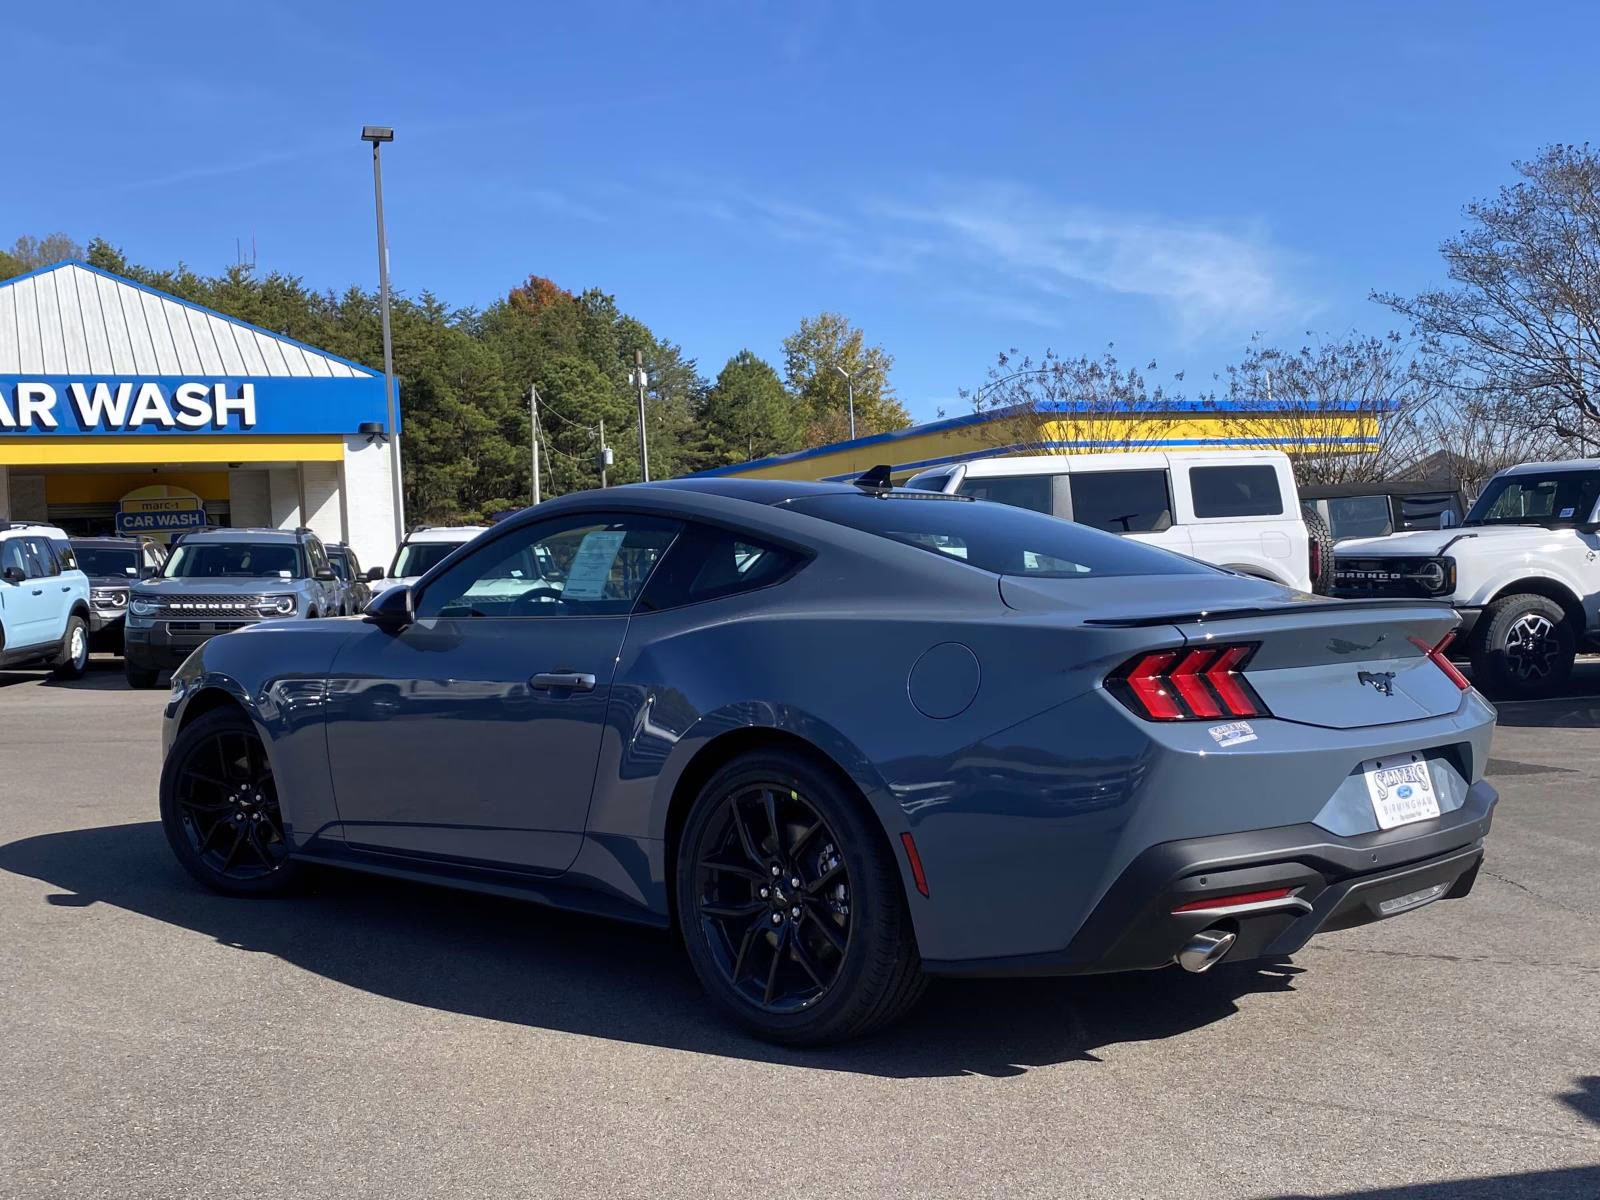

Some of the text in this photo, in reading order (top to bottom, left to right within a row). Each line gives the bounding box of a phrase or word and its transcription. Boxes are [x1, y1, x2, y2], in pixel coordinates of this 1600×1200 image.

[71, 383, 256, 427] WASH
[123, 513, 200, 528] CAR WASH
[1336, 572, 1401, 580] BRONCO
